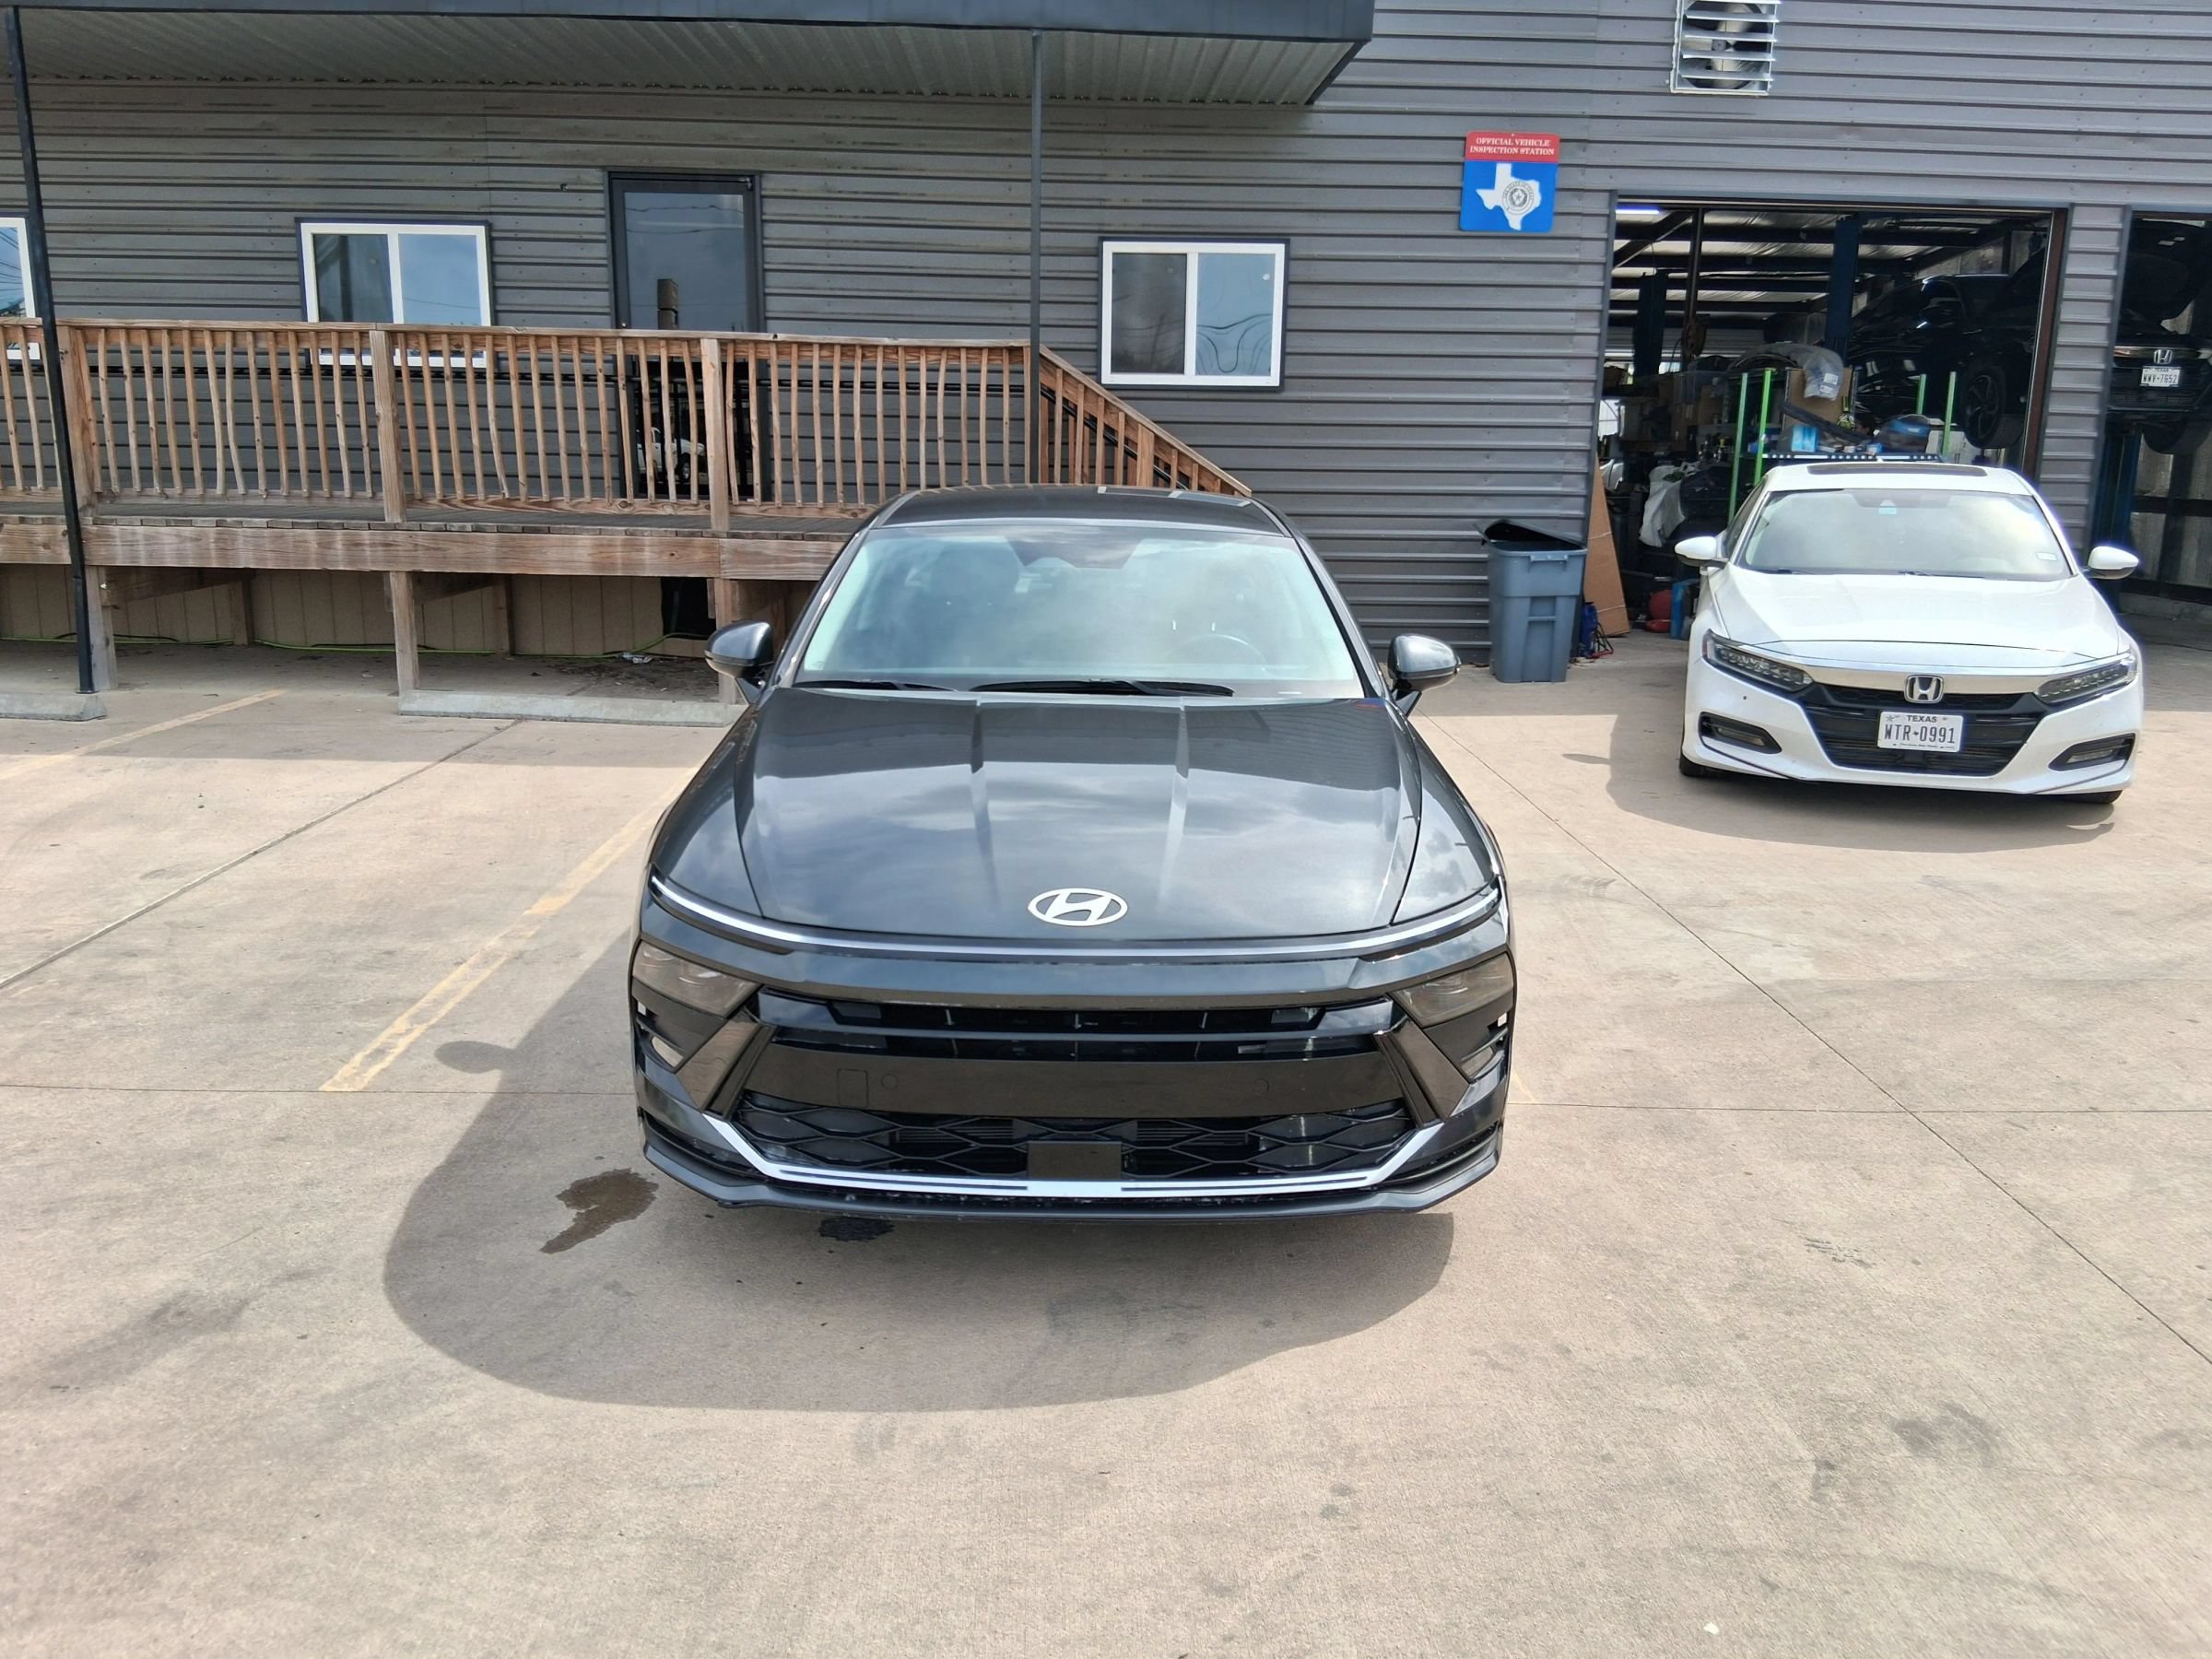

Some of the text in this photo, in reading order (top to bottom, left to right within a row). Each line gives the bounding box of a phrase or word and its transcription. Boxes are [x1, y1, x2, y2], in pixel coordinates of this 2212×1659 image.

[1476, 137, 1513, 146] OFFICIAL
[1470, 146, 1555, 156] INSPECTION STATION
